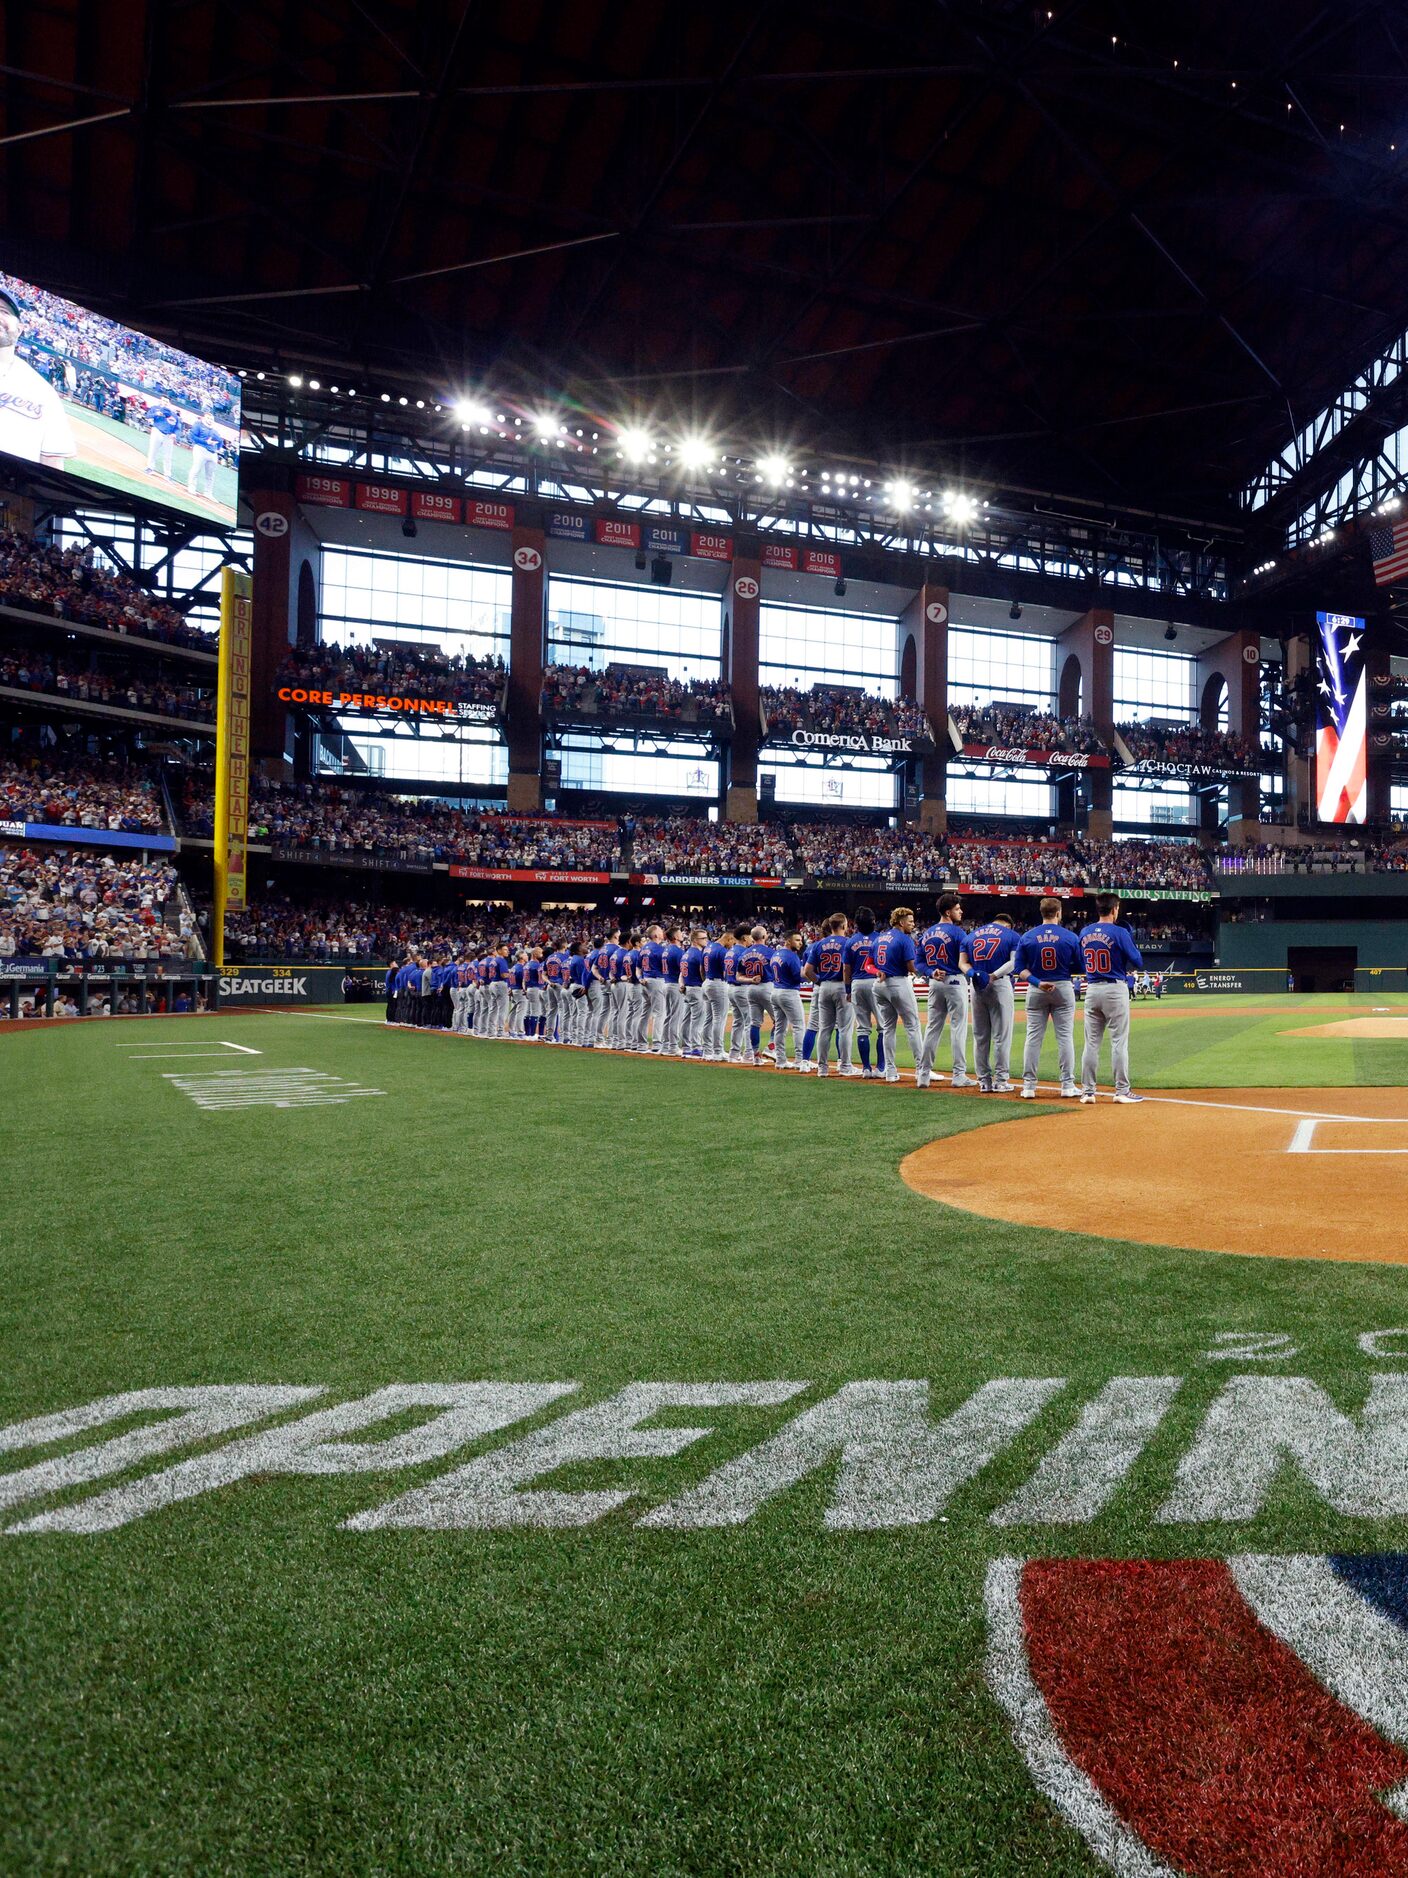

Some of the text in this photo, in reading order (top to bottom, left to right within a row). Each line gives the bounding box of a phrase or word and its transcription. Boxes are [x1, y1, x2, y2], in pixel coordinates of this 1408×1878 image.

[306, 476, 341, 493] 1996
[365, 485, 399, 501] 1998
[420, 493, 453, 509] 1999
[475, 502, 507, 517] 2010
[258, 517, 286, 532] 42
[553, 514, 583, 528] 2010
[605, 521, 632, 536] 2011
[652, 528, 677, 542] 2011
[699, 535, 726, 549] 2012
[766, 545, 791, 559] 2015
[809, 551, 835, 565] 2016
[518, 552, 537, 567] 34
[738, 581, 756, 595] 26
[932, 606, 943, 619] 7
[1096, 628, 1112, 642] 29
[236, 602, 247, 693] BRING
[1246, 649, 1257, 661] 10
[278, 687, 458, 716] CORE PERSONNEL
[457, 702, 497, 712] STAFFING
[234, 700, 244, 753] THE
[871, 736, 913, 752] Bank
[1146, 759, 1212, 775] CHOCTAW
[233, 760, 244, 833] HEAT
[279, 851, 311, 861] SHIFT
[361, 859, 390, 868] SHIFT
[469, 871, 512, 880] FORT WORTH
[550, 874, 599, 883] FORT WORTH
[660, 875, 720, 885] GARDENERS
[722, 877, 752, 886] TRUST
[969, 884, 990, 892] DEX
[997, 885, 1018, 893] DEX
[1025, 886, 1045, 894] DEX
[1052, 886, 1073, 895] DEX
[1152, 889, 1210, 901] STAFFING
[877, 944, 888, 966] 5
[925, 943, 949, 967] 24
[972, 937, 1002, 963] 27
[819, 952, 842, 973] 29
[1040, 947, 1057, 971] 8
[1083, 948, 1112, 974] 30
[9, 962, 45, 974] Germania
[219, 968, 240, 977] 329
[272, 969, 291, 977] 334
[745, 960, 764, 979] 20
[218, 976, 308, 996] SEATGEEK
